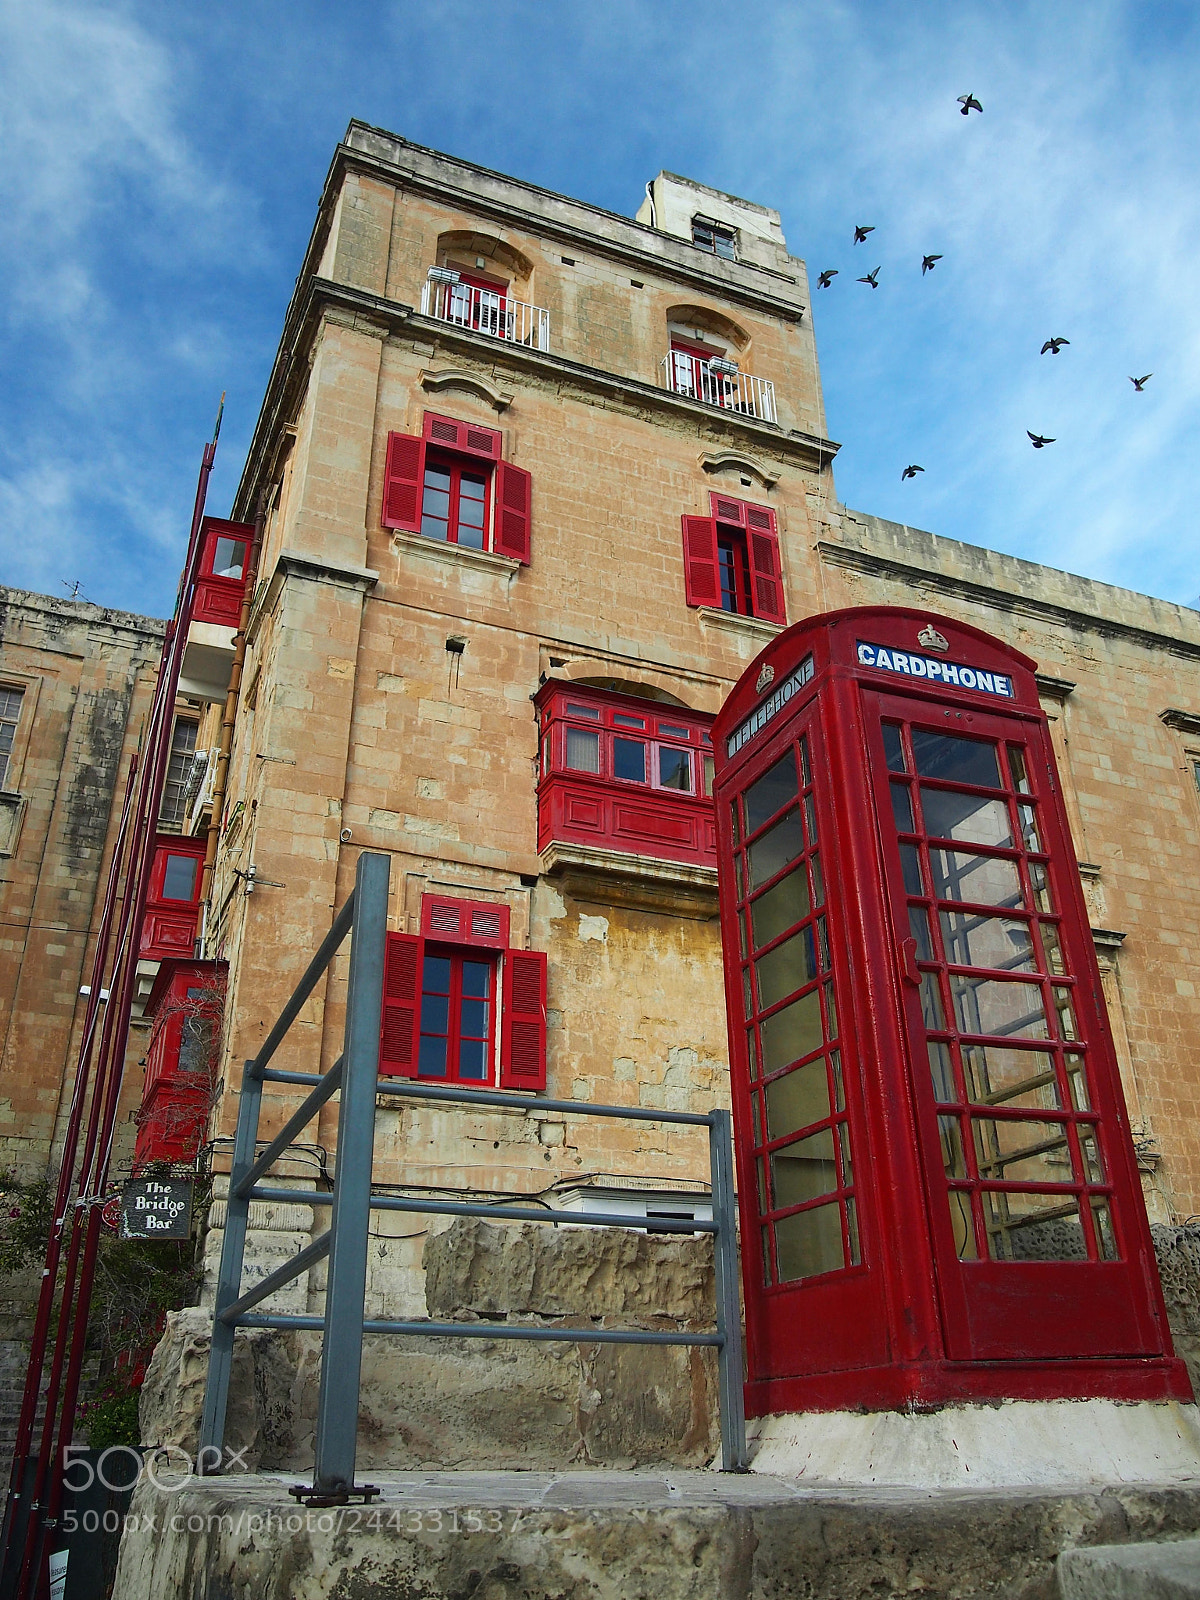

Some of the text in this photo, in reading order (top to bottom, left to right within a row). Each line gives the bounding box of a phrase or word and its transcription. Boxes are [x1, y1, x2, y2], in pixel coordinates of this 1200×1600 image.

[857, 644, 1009, 696] CARDPHONE
[731, 659, 812, 752] TELEPHONE
[145, 1182, 172, 1194] The
[134, 1195, 185, 1218] Bridge
[145, 1214, 172, 1229] Bar
